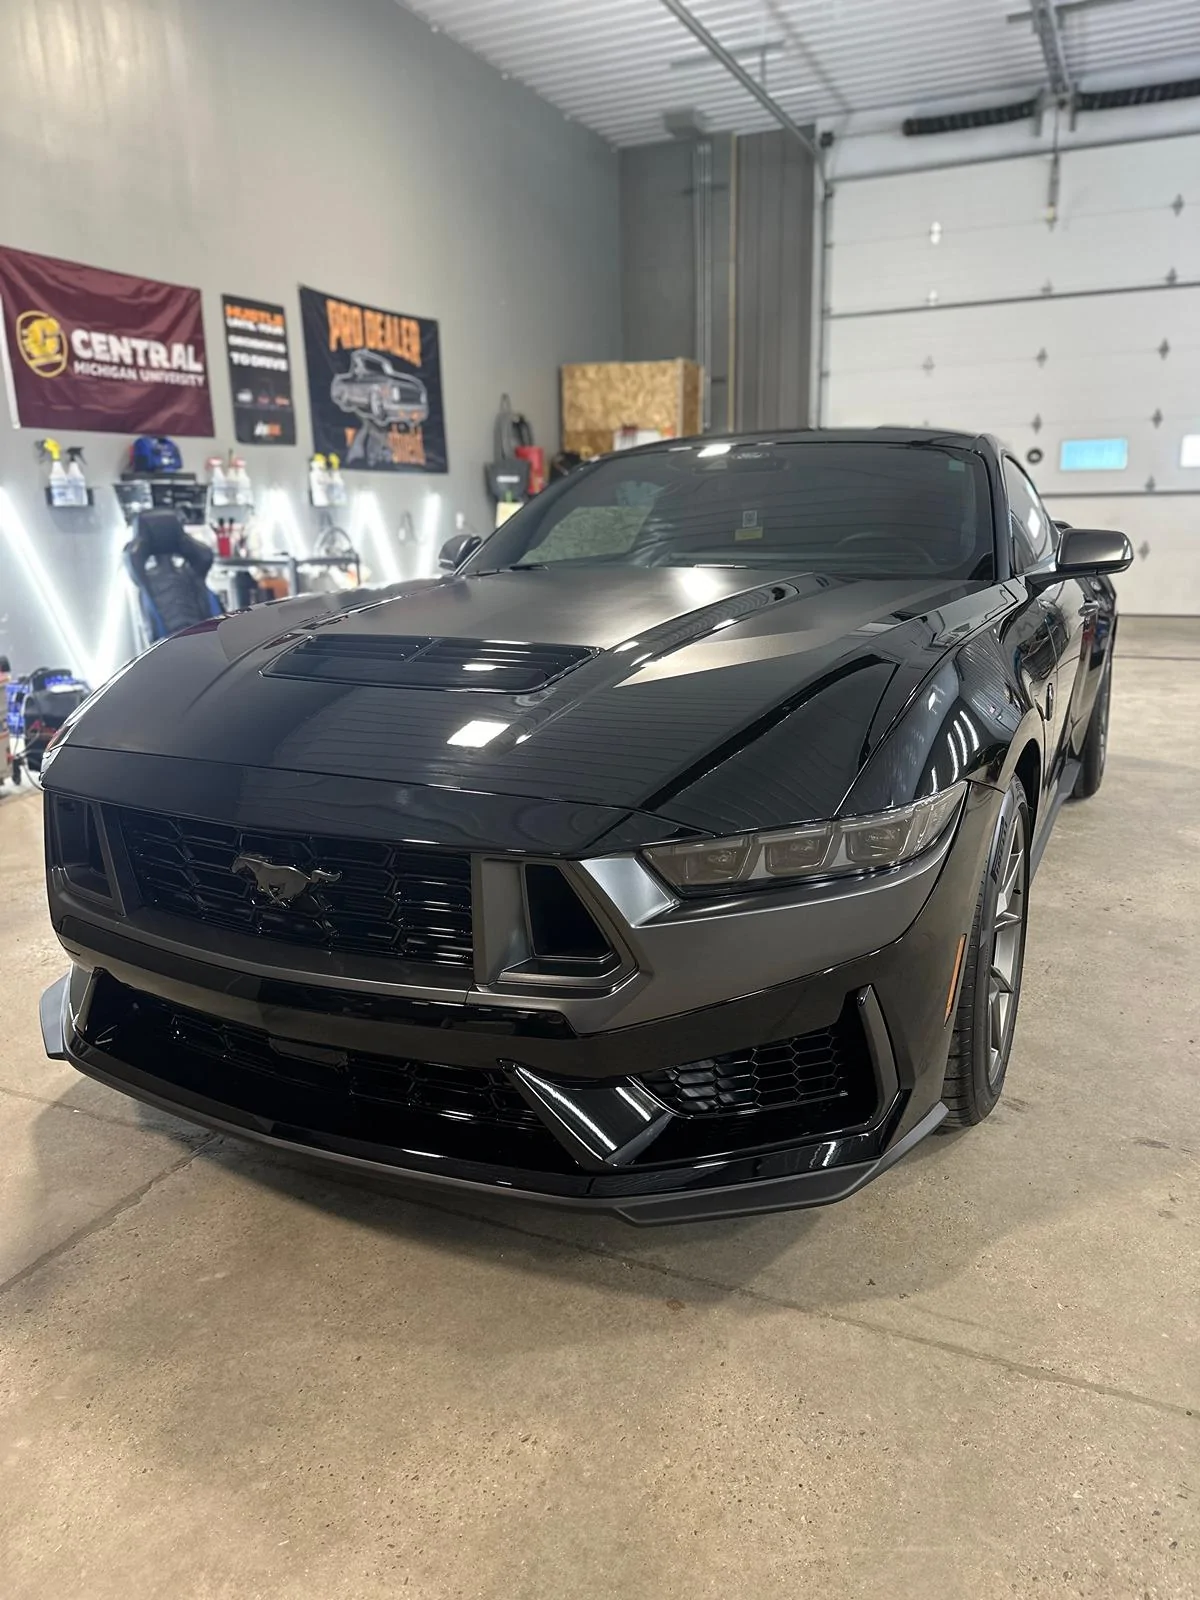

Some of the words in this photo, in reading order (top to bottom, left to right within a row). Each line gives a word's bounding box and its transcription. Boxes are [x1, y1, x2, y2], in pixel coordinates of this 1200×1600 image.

[326, 299, 364, 352] PRO
[71, 329, 203, 372] CENTRAL
[73, 360, 138, 380] MICHIGAN
[140, 368, 205, 387] UNIVERSITY
